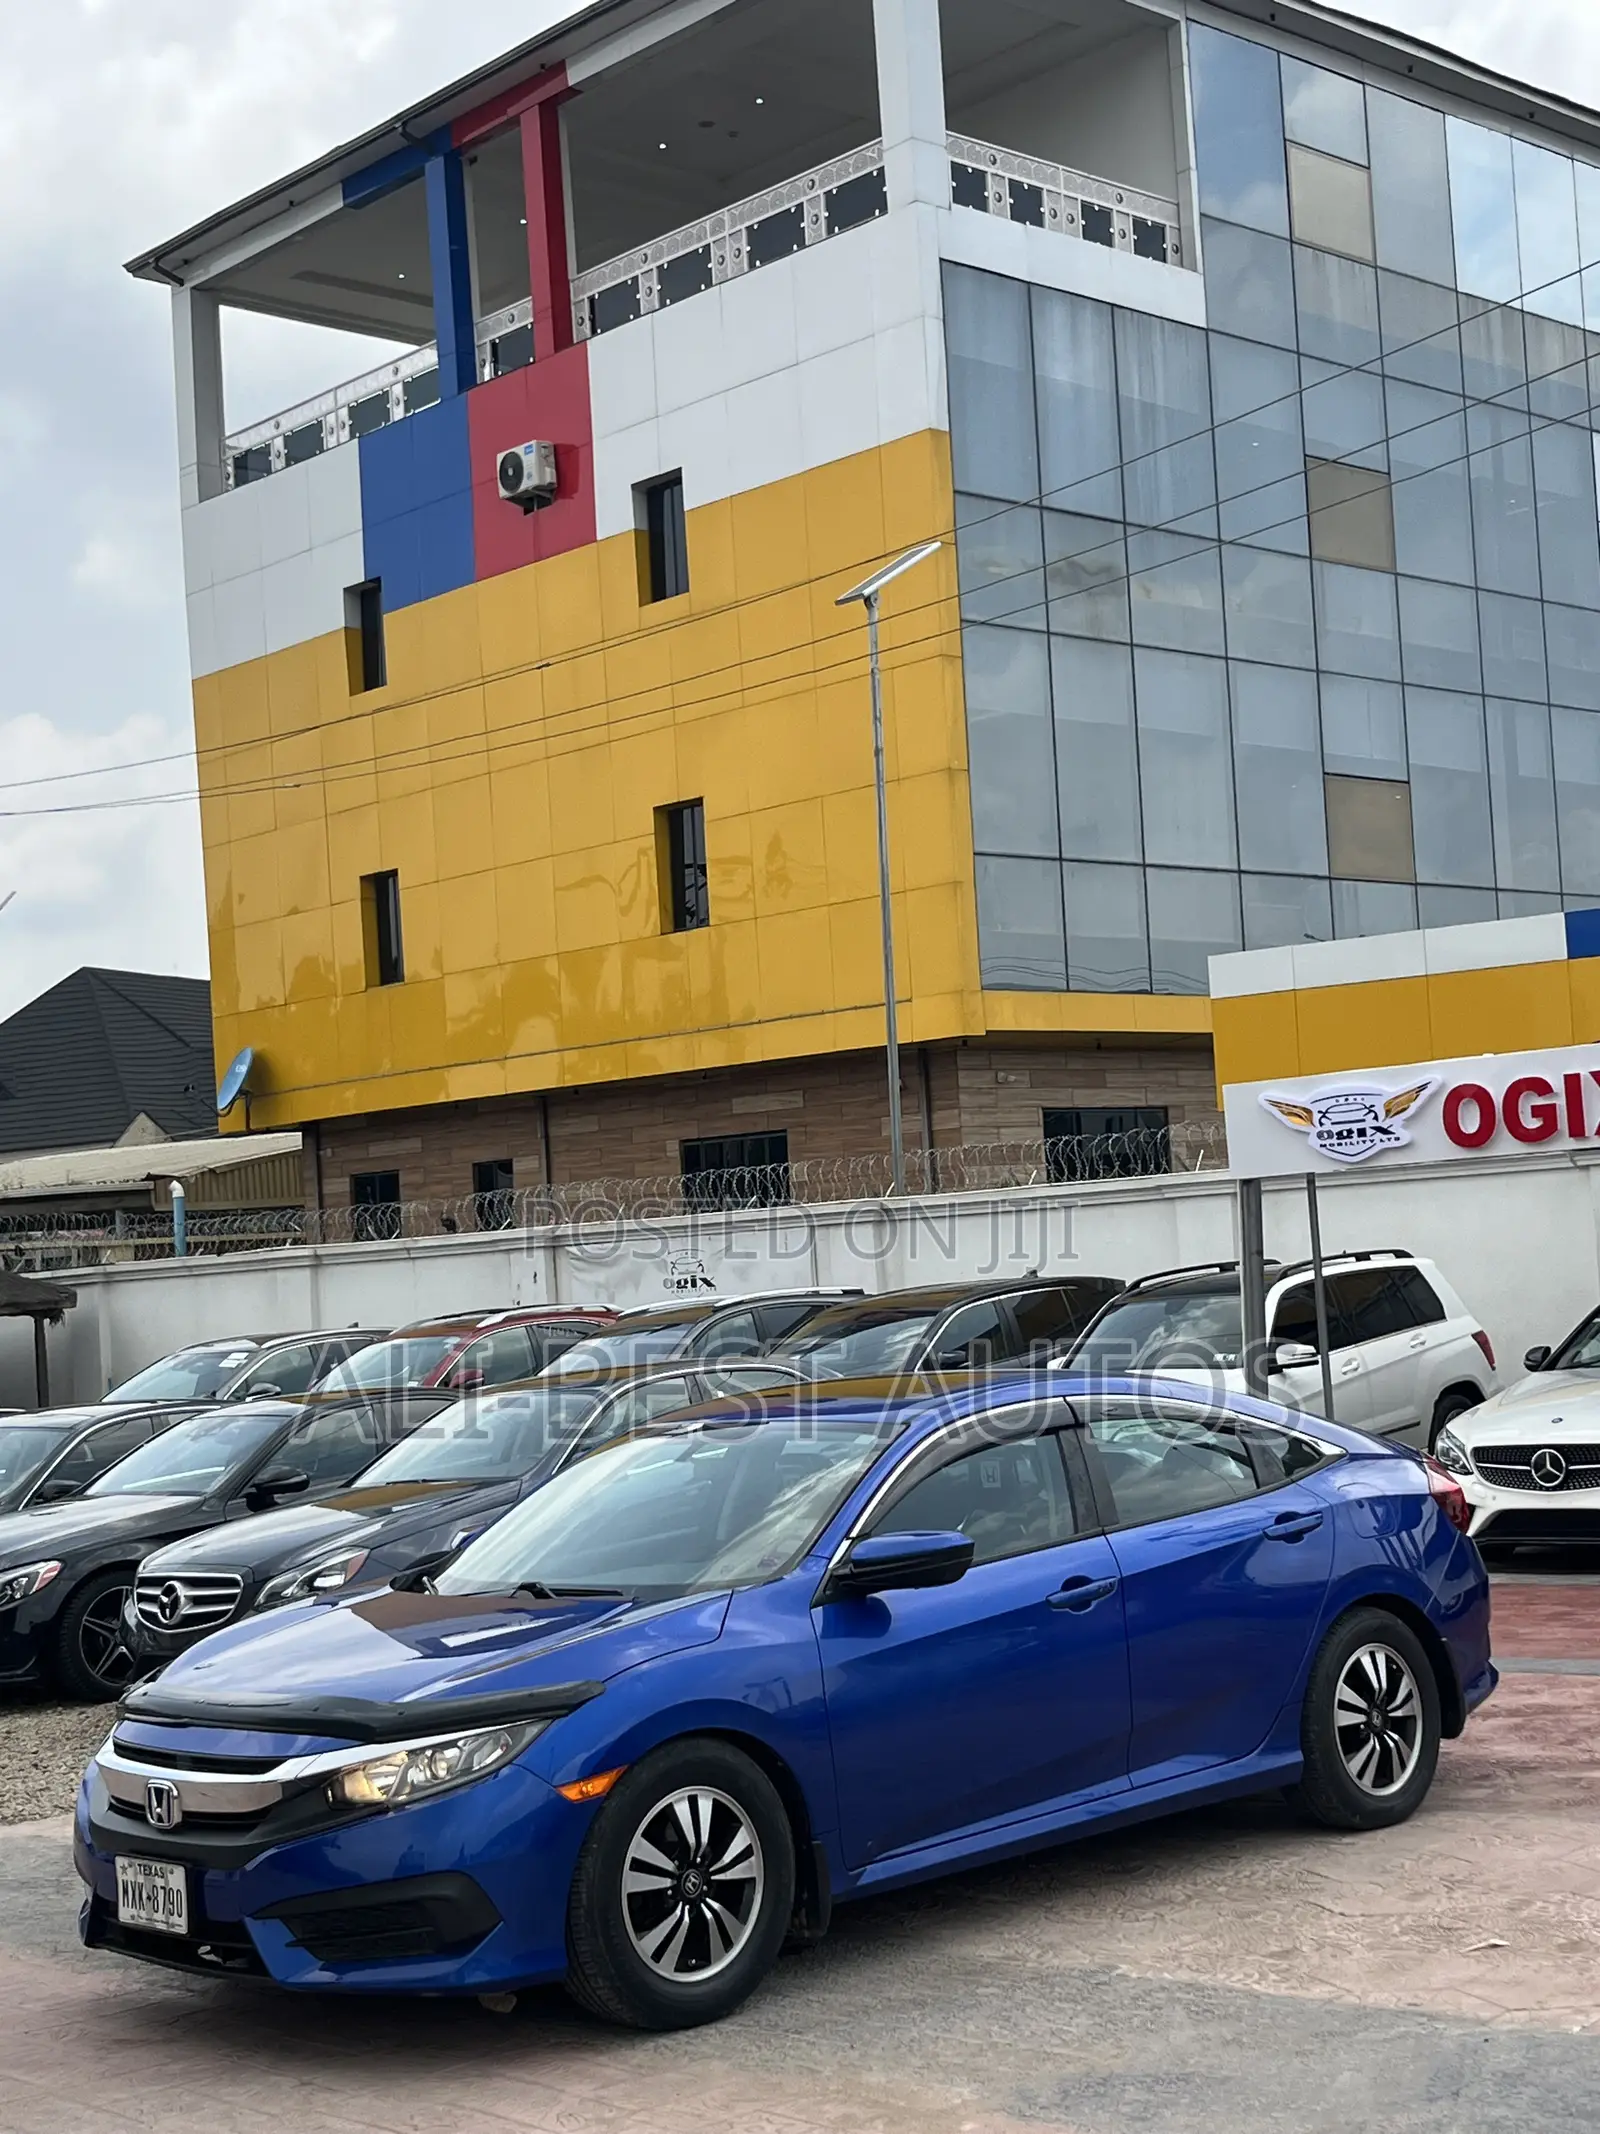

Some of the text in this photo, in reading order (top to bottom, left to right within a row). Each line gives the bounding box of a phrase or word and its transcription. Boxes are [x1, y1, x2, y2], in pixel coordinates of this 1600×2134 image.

[1442, 1070, 1600, 1148] OGI
[1319, 1138, 1375, 1148] MOBILITY
[137, 1863, 165, 1879] TEXAS
